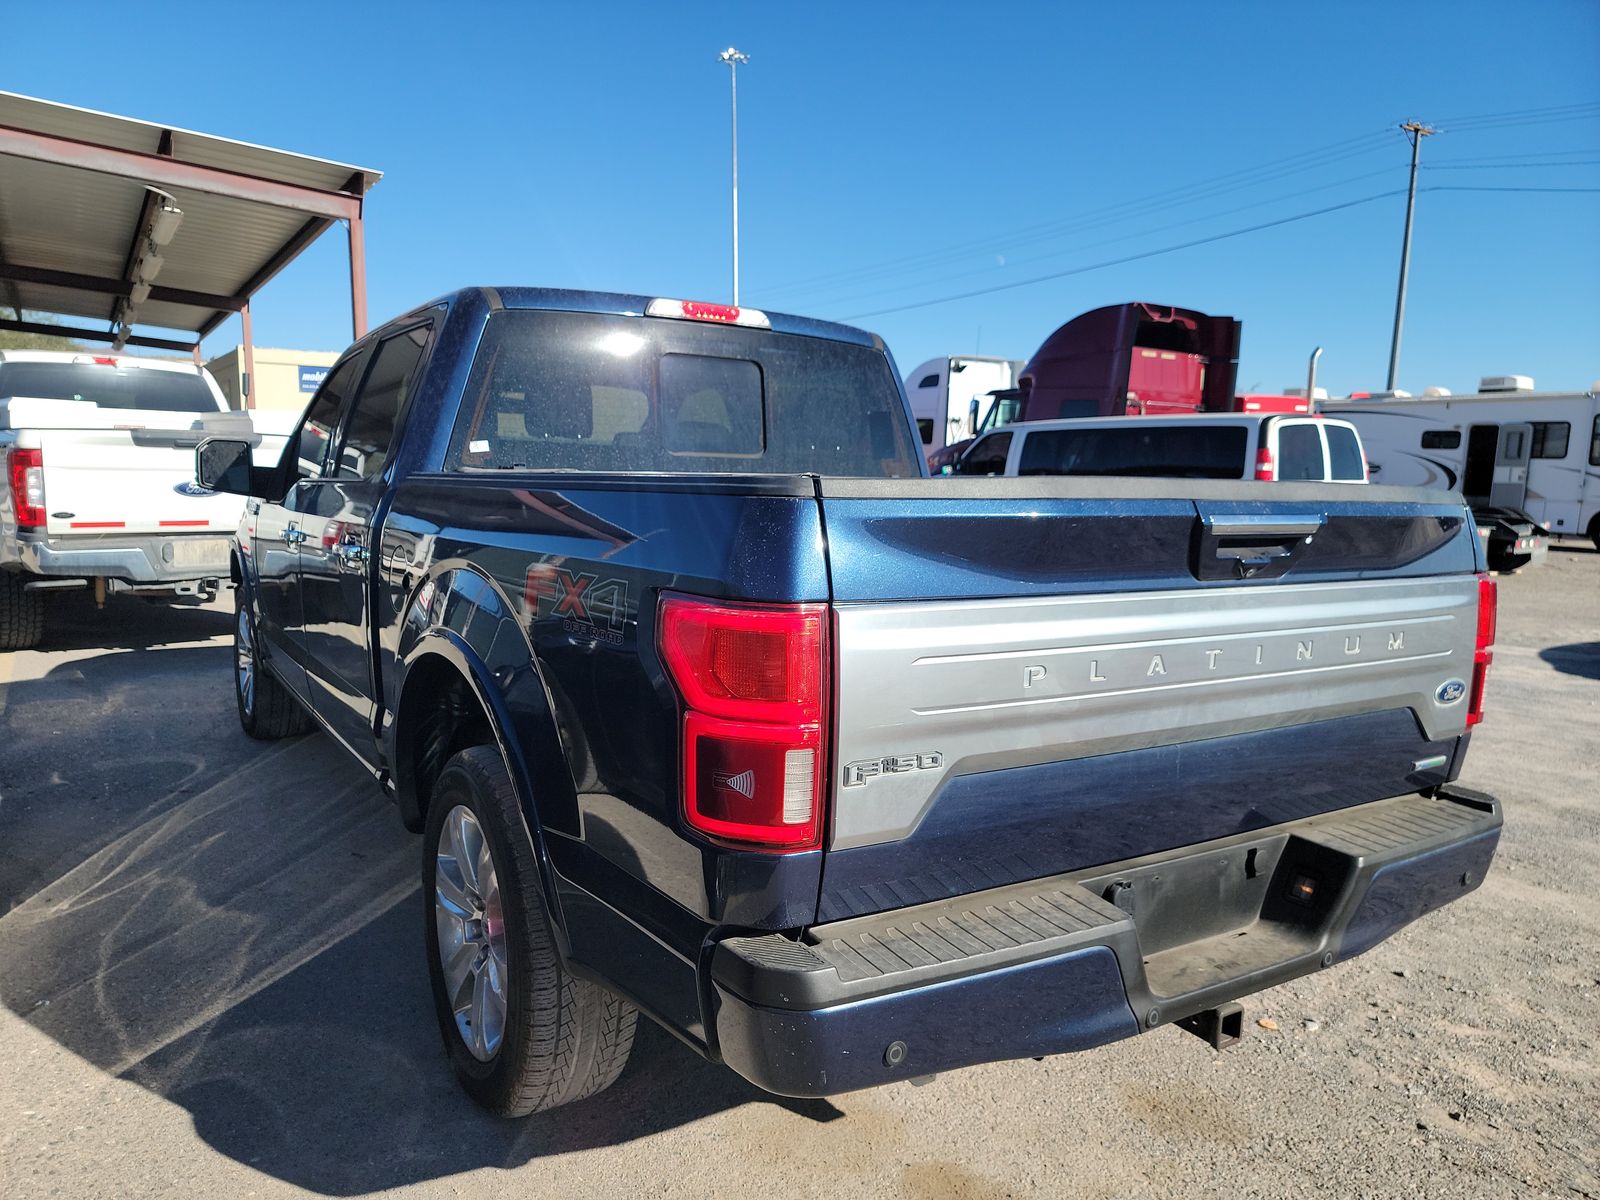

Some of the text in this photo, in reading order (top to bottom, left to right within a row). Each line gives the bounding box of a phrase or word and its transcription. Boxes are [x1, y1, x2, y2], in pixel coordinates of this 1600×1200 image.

[523, 562, 629, 635] FX4
[589, 626, 625, 646] ROAD
[1022, 631, 1406, 689] PLATINUM
